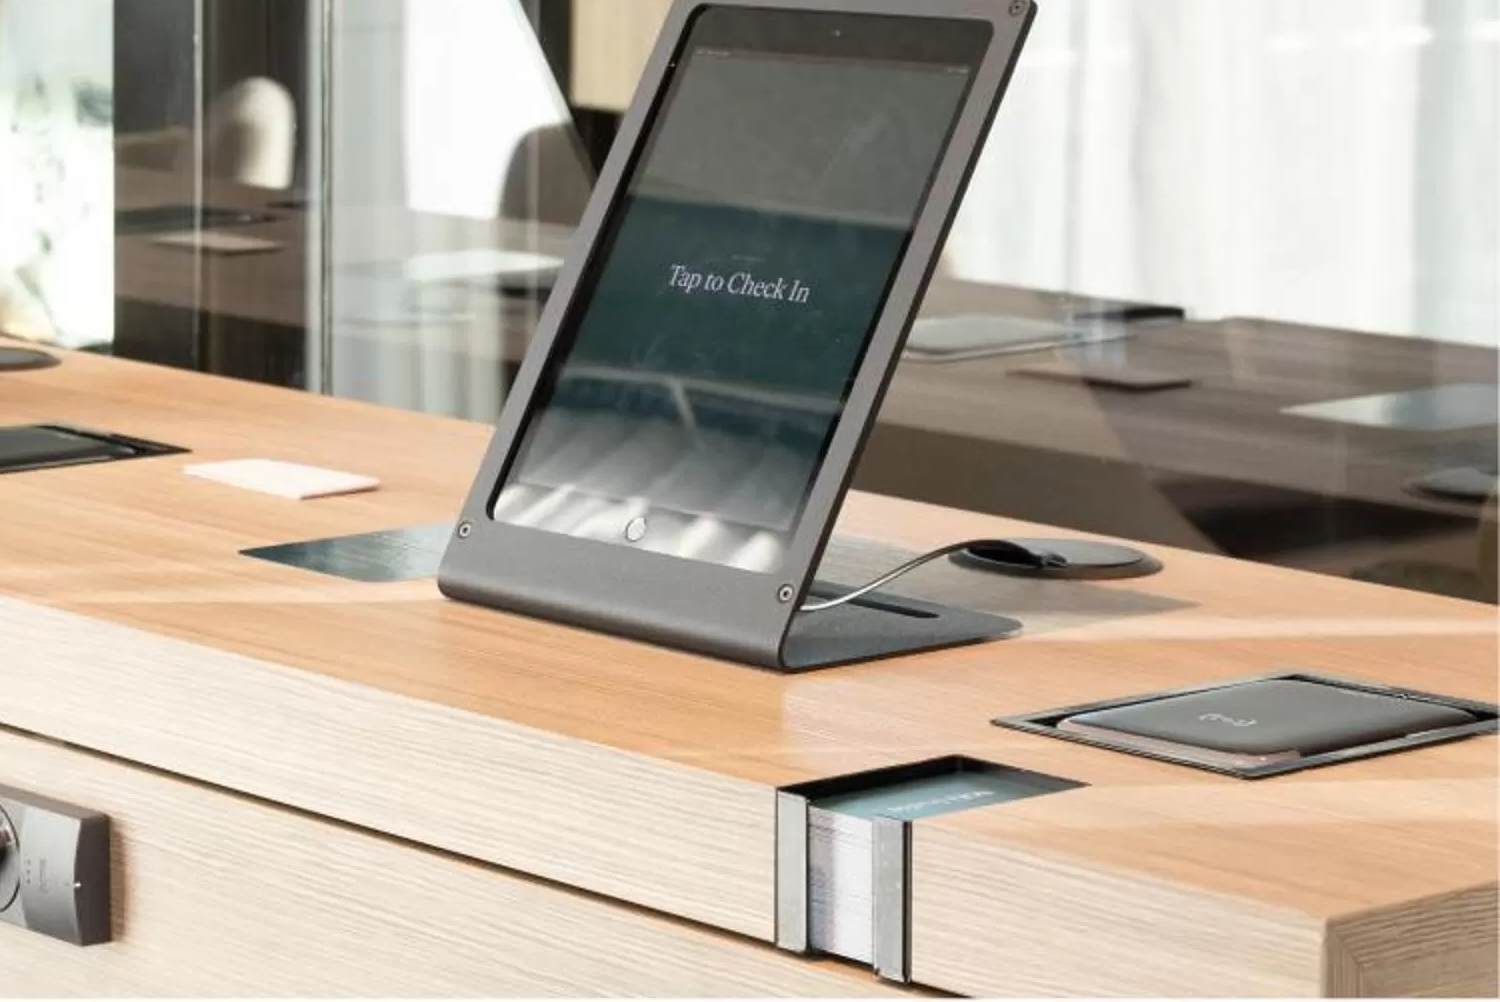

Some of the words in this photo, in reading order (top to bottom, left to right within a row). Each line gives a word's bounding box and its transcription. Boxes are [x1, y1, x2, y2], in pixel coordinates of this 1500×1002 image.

[668, 263, 703, 295] Tap
[704, 273, 725, 291] to
[726, 271, 788, 300] Check
[787, 279, 811, 303] In
